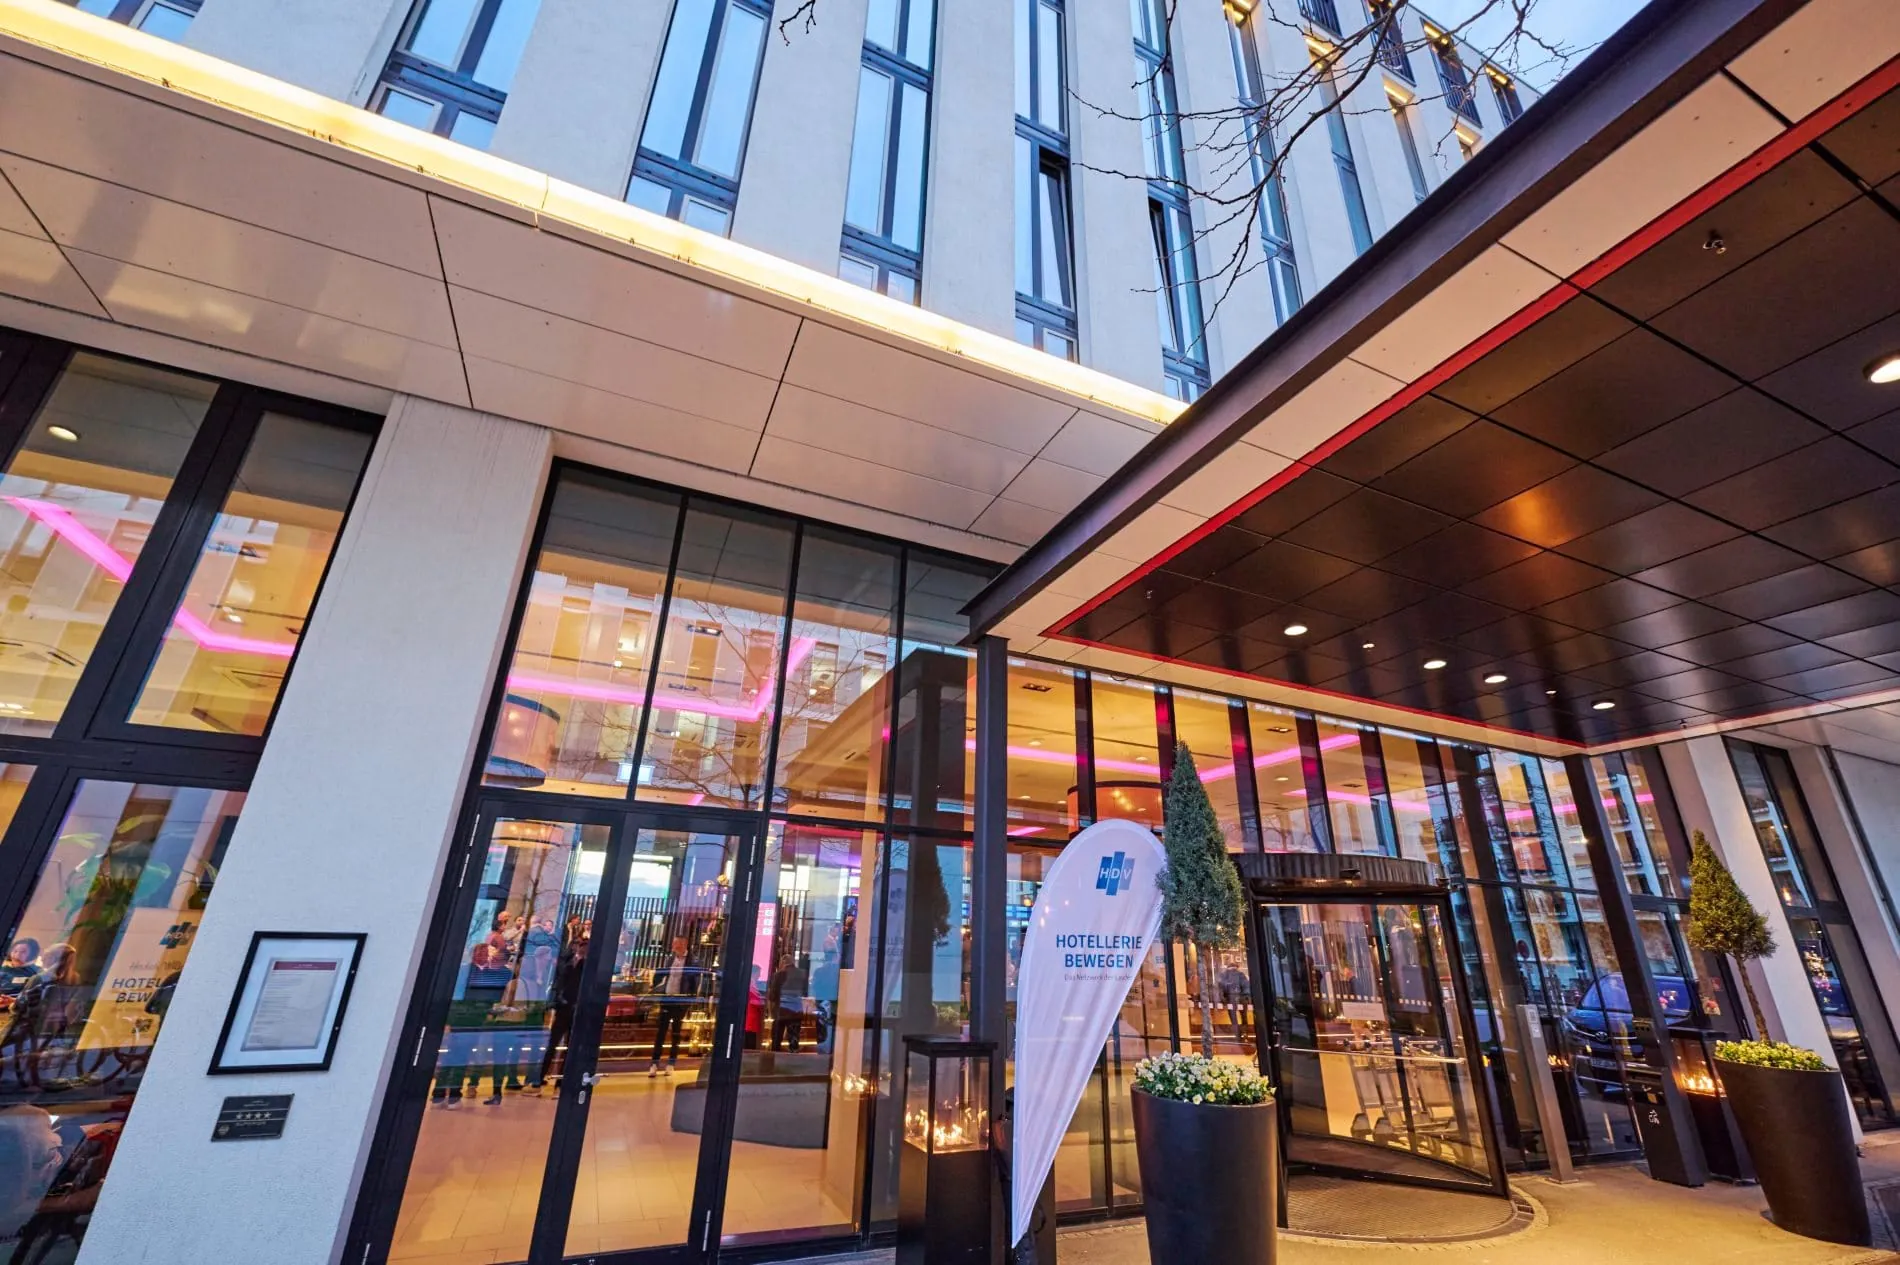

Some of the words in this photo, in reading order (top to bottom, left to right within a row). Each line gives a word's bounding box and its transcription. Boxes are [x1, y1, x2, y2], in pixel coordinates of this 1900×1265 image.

[1100, 867, 1132, 879] HDV
[1056, 934, 1143, 949] HOTELLERIE
[1064, 953, 1134, 968] BEWEGEN
[112, 978, 162, 989] HOTEL
